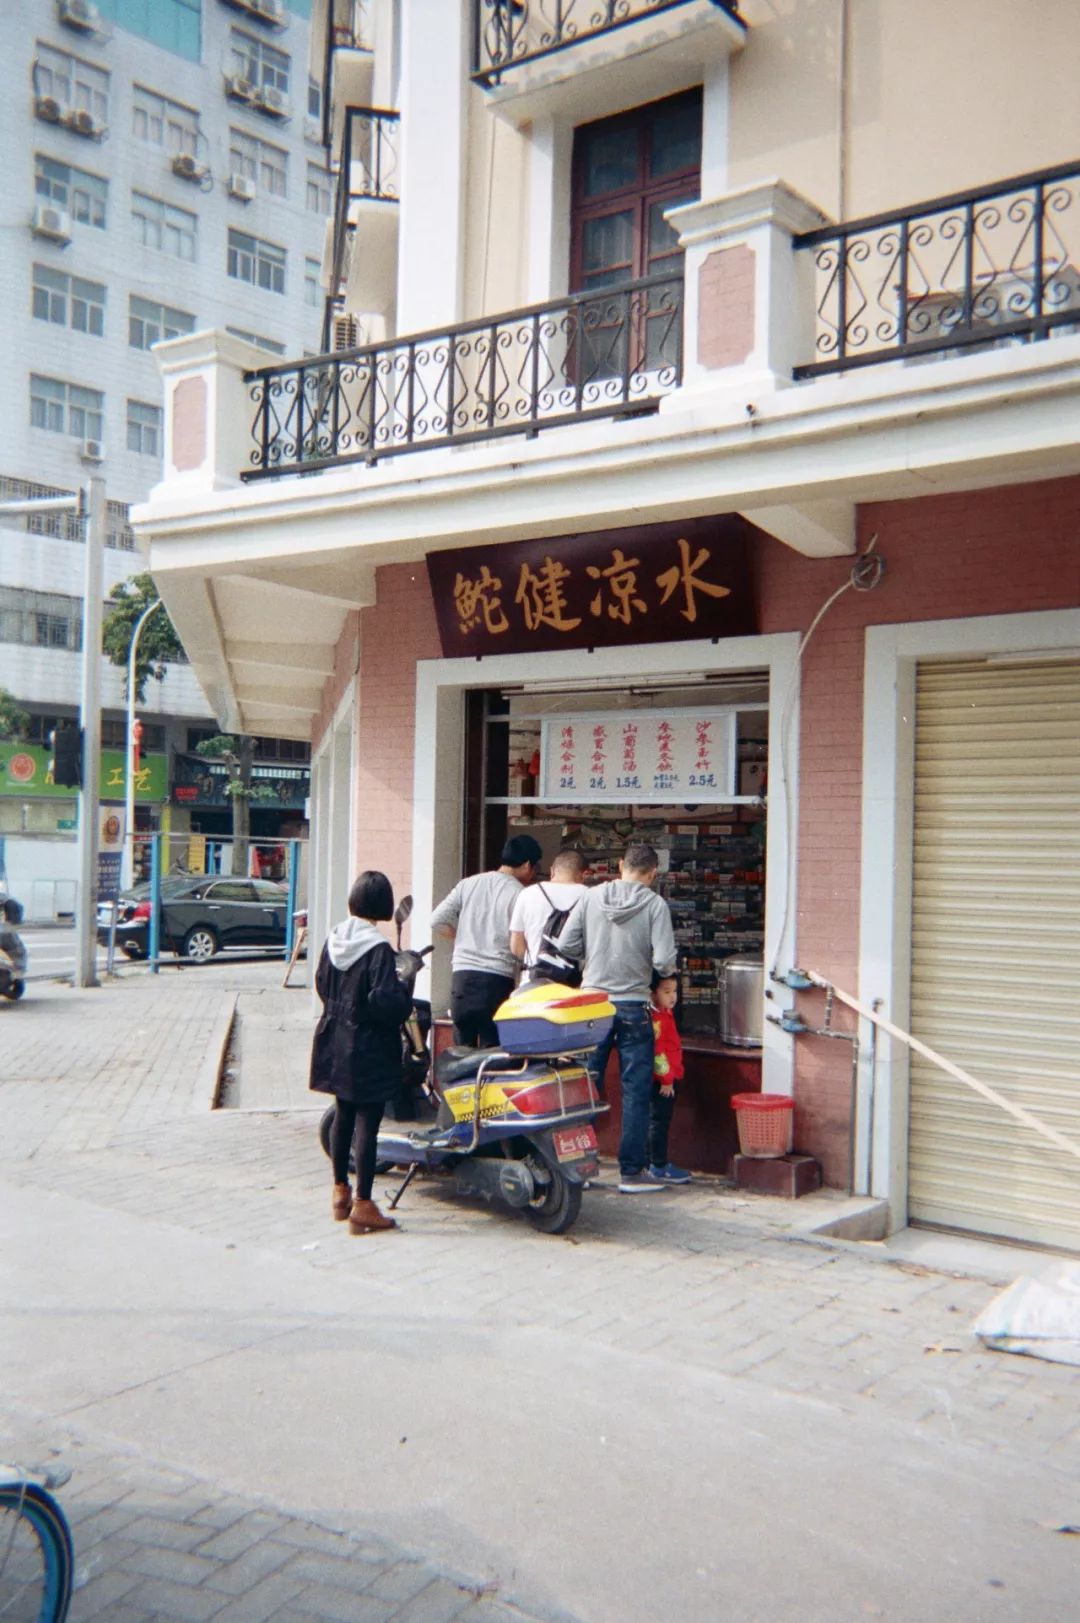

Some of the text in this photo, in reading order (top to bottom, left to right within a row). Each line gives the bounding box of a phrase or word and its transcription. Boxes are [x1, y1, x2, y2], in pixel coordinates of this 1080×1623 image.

[560, 777, 576, 789] 2元
[590, 776, 606, 789] 2元
[616, 776, 641, 789] 1.5元
[689, 774, 718, 788] 2.5元
